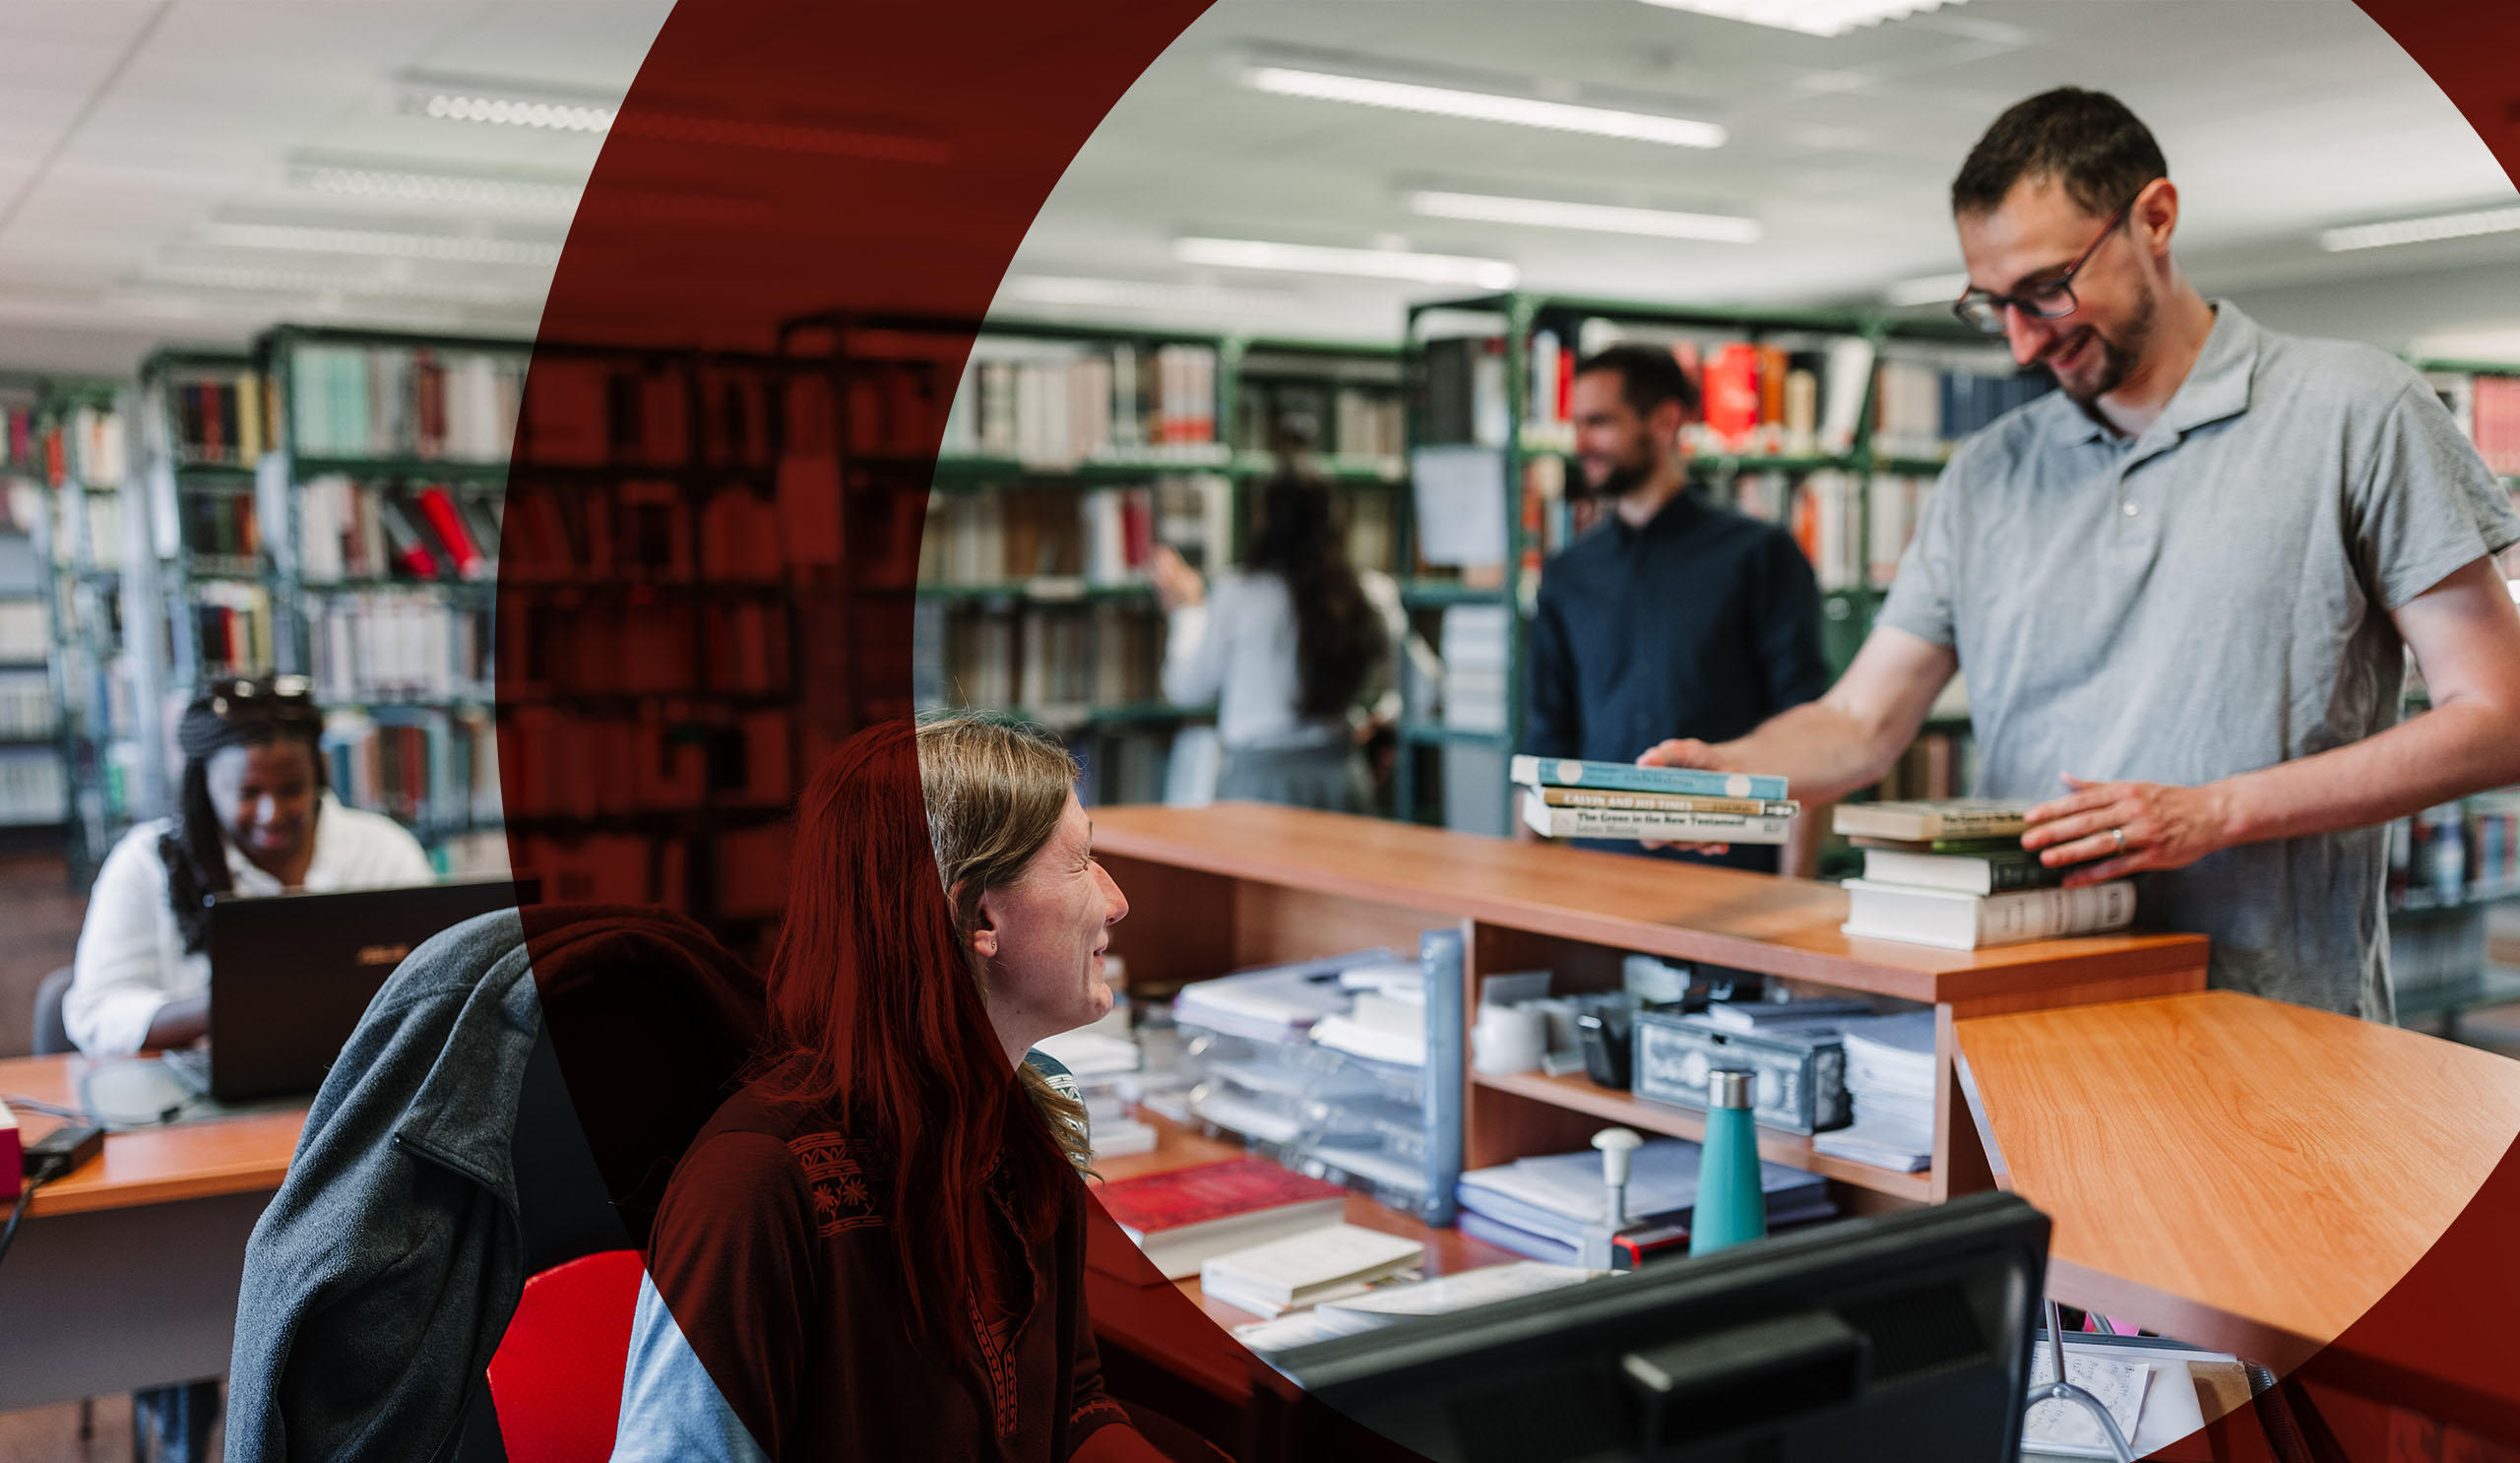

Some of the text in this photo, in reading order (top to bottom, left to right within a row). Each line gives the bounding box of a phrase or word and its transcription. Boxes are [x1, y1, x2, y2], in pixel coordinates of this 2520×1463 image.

[1563, 794, 1606, 805] CALVIN
[1607, 795, 1633, 806] AND
[1659, 799, 1692, 811] TIMES
[1577, 812, 1596, 821] The
[1632, 813, 1643, 822] in
[1645, 814, 1660, 823] the
[1664, 815, 1685, 824] New
[1690, 816, 1746, 826] Testament
